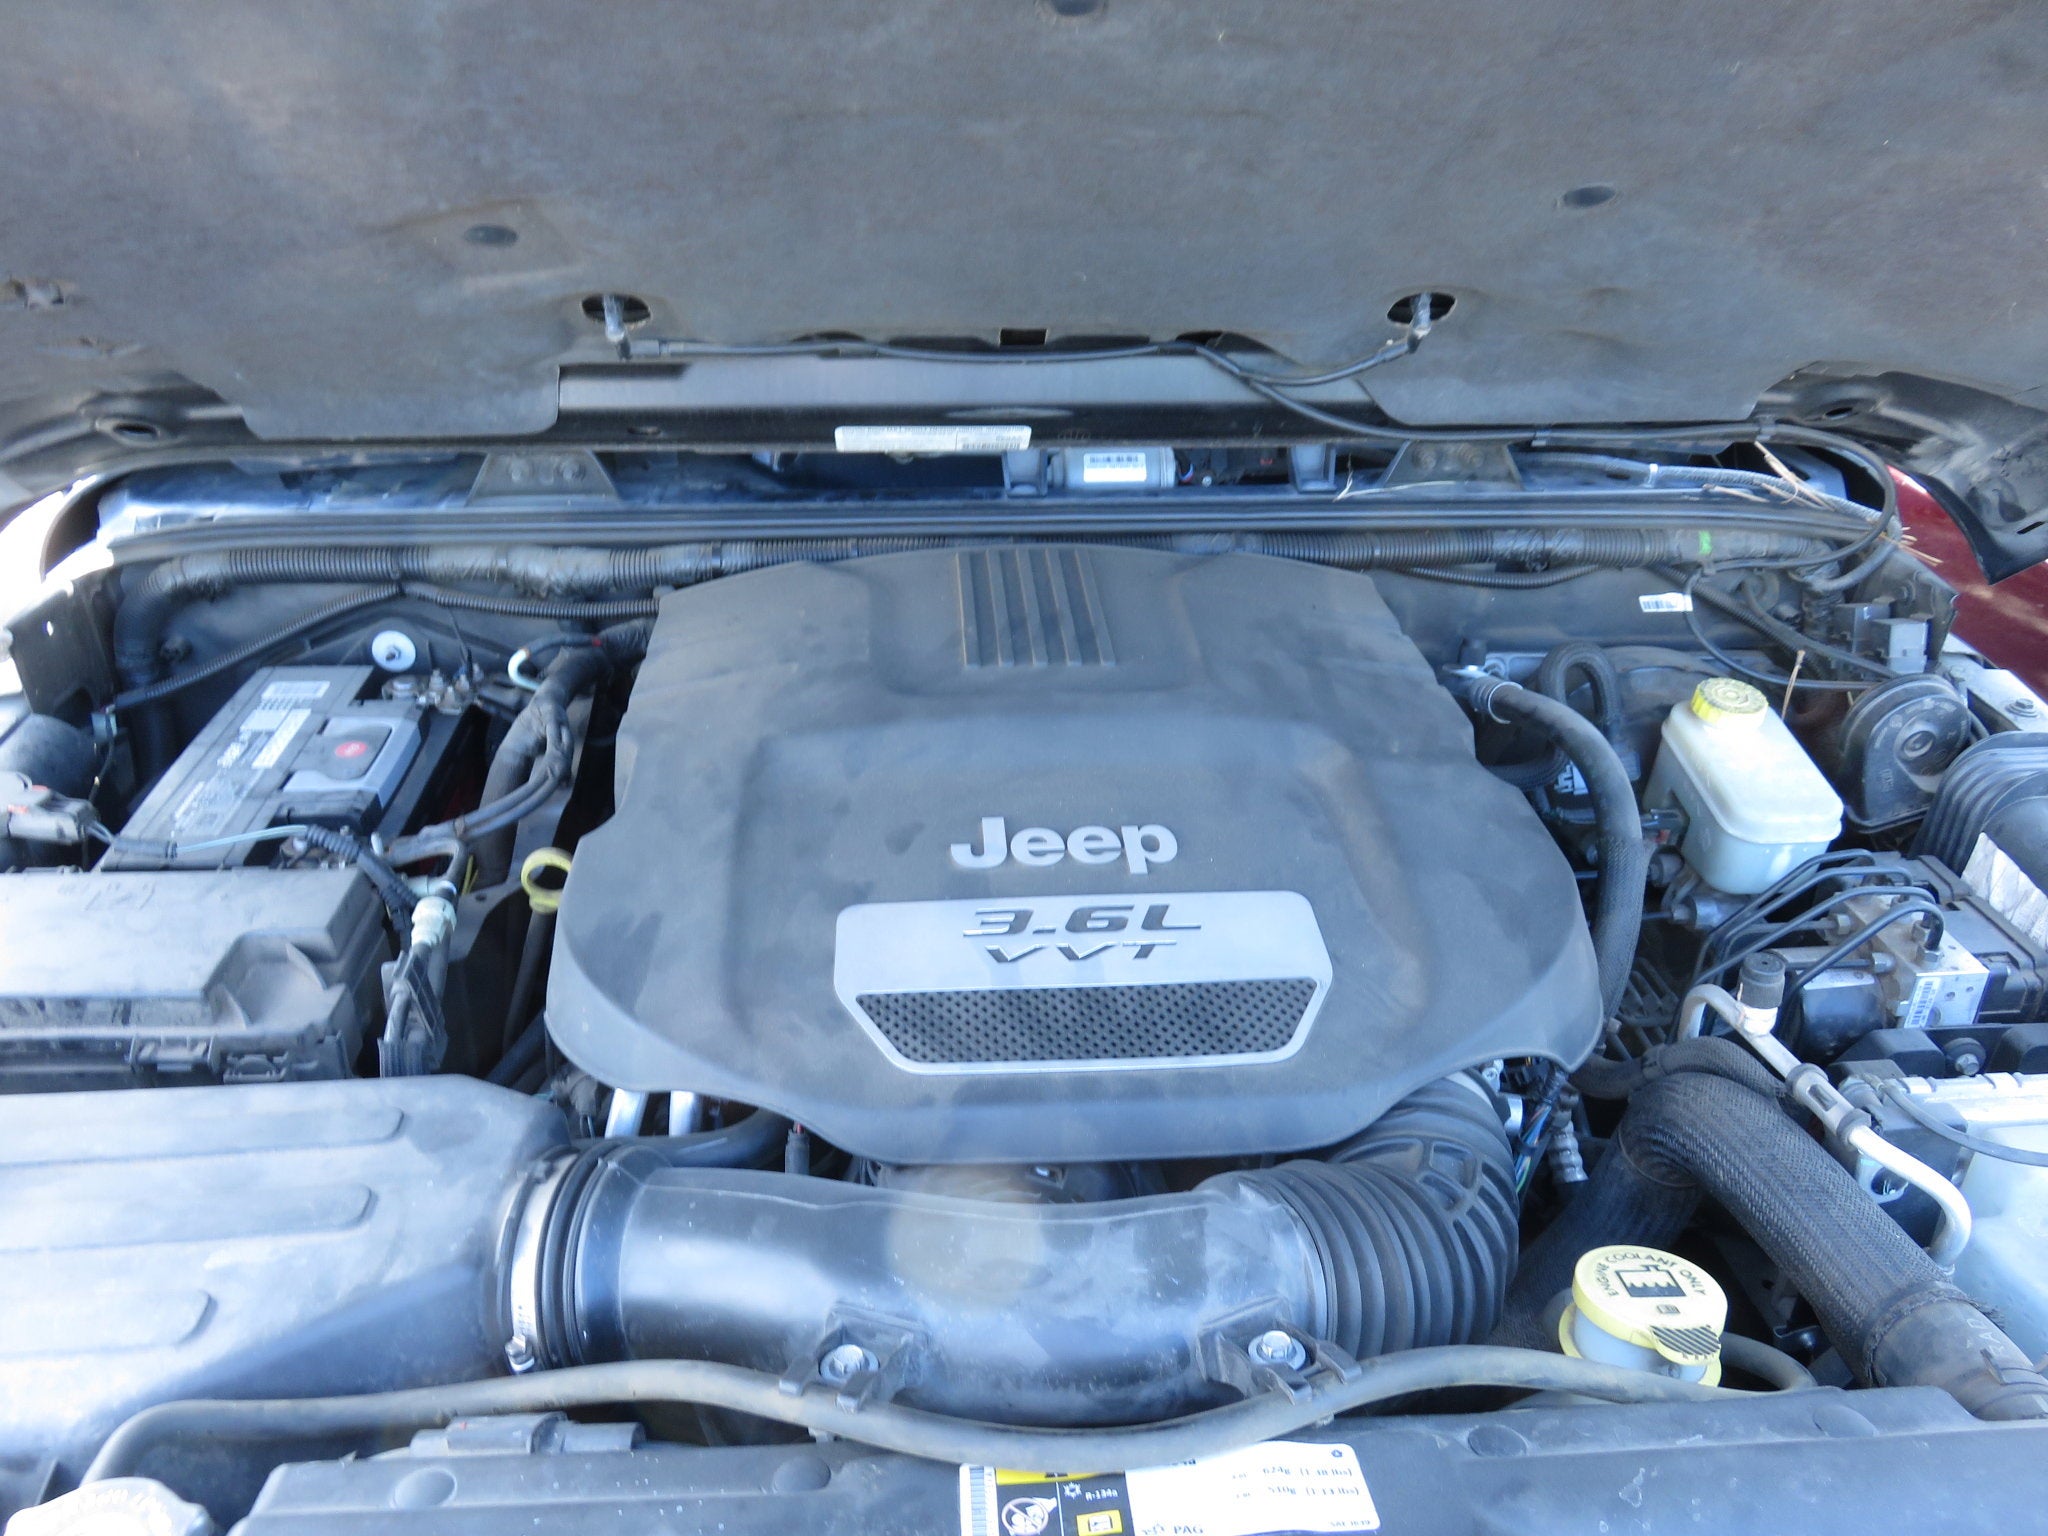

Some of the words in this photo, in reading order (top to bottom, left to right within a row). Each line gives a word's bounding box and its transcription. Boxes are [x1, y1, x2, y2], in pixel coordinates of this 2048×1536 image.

[951, 816, 1178, 875] Jeep
[963, 904, 1202, 936] 3.6L
[984, 939, 1177, 963] VVT
[1605, 1252, 1678, 1268] COOLANT
[1596, 1262, 1619, 1297] ENGINE
[1679, 1268, 1707, 1296] ONLY
